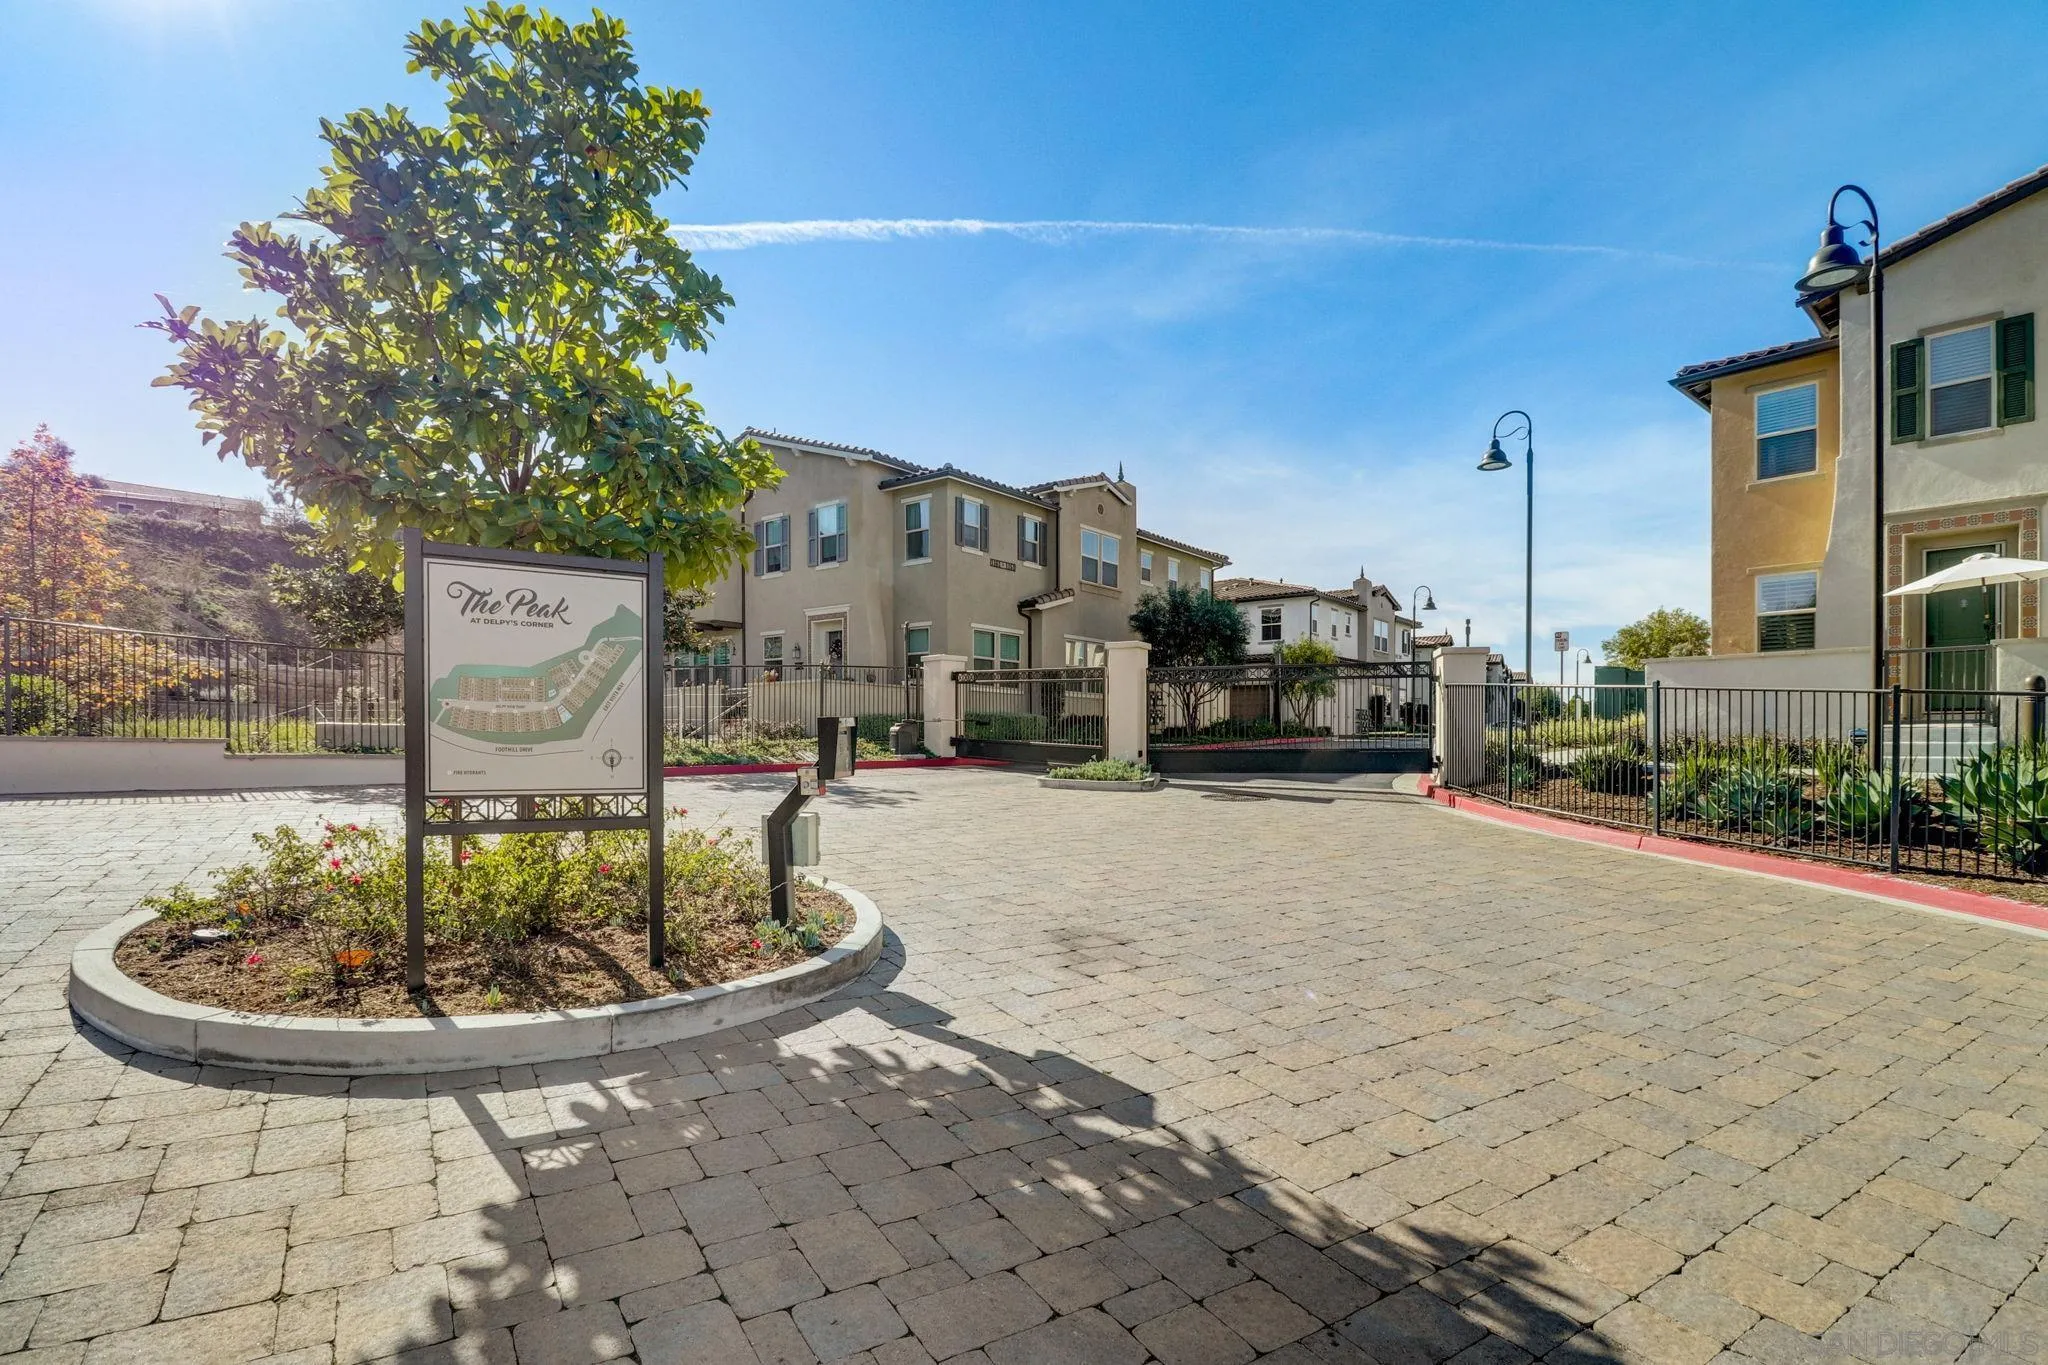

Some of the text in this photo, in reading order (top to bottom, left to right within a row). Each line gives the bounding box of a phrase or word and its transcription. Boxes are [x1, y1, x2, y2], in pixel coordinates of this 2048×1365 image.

[446, 581, 573, 626] The Peak
[483, 618, 519, 627] DELPY'S
[520, 620, 554, 629] CORNER
